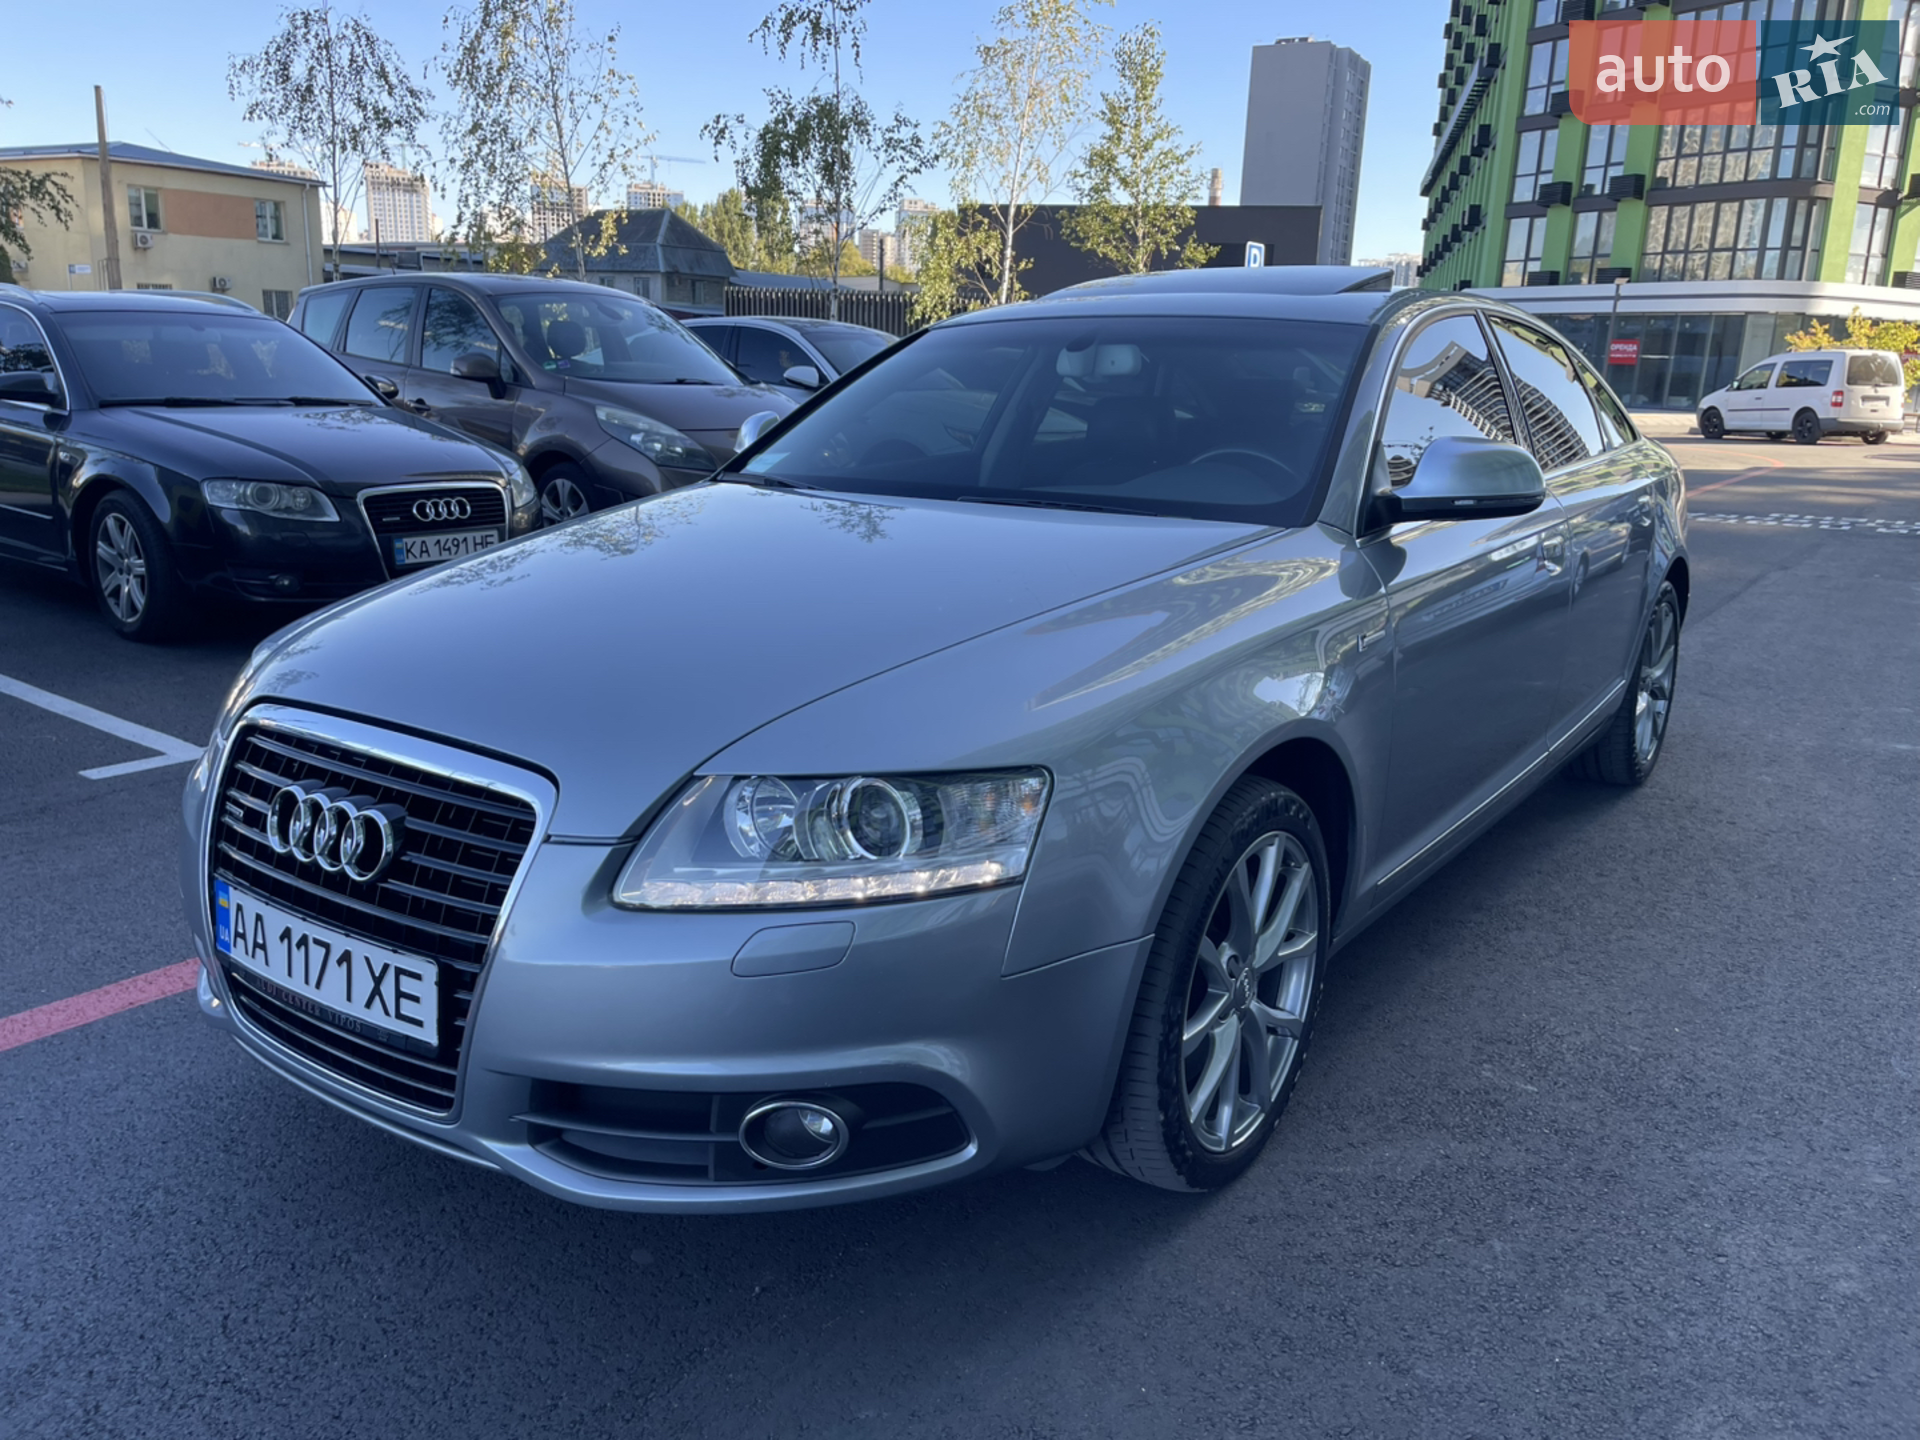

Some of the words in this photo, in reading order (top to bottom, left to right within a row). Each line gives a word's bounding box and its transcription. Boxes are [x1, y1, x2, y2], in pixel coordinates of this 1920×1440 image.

[404, 540, 431, 559] KA
[433, 536, 470, 557] 1491
[233, 902, 270, 967] AA
[279, 925, 352, 1003] 1171
[363, 955, 424, 1028] XE
